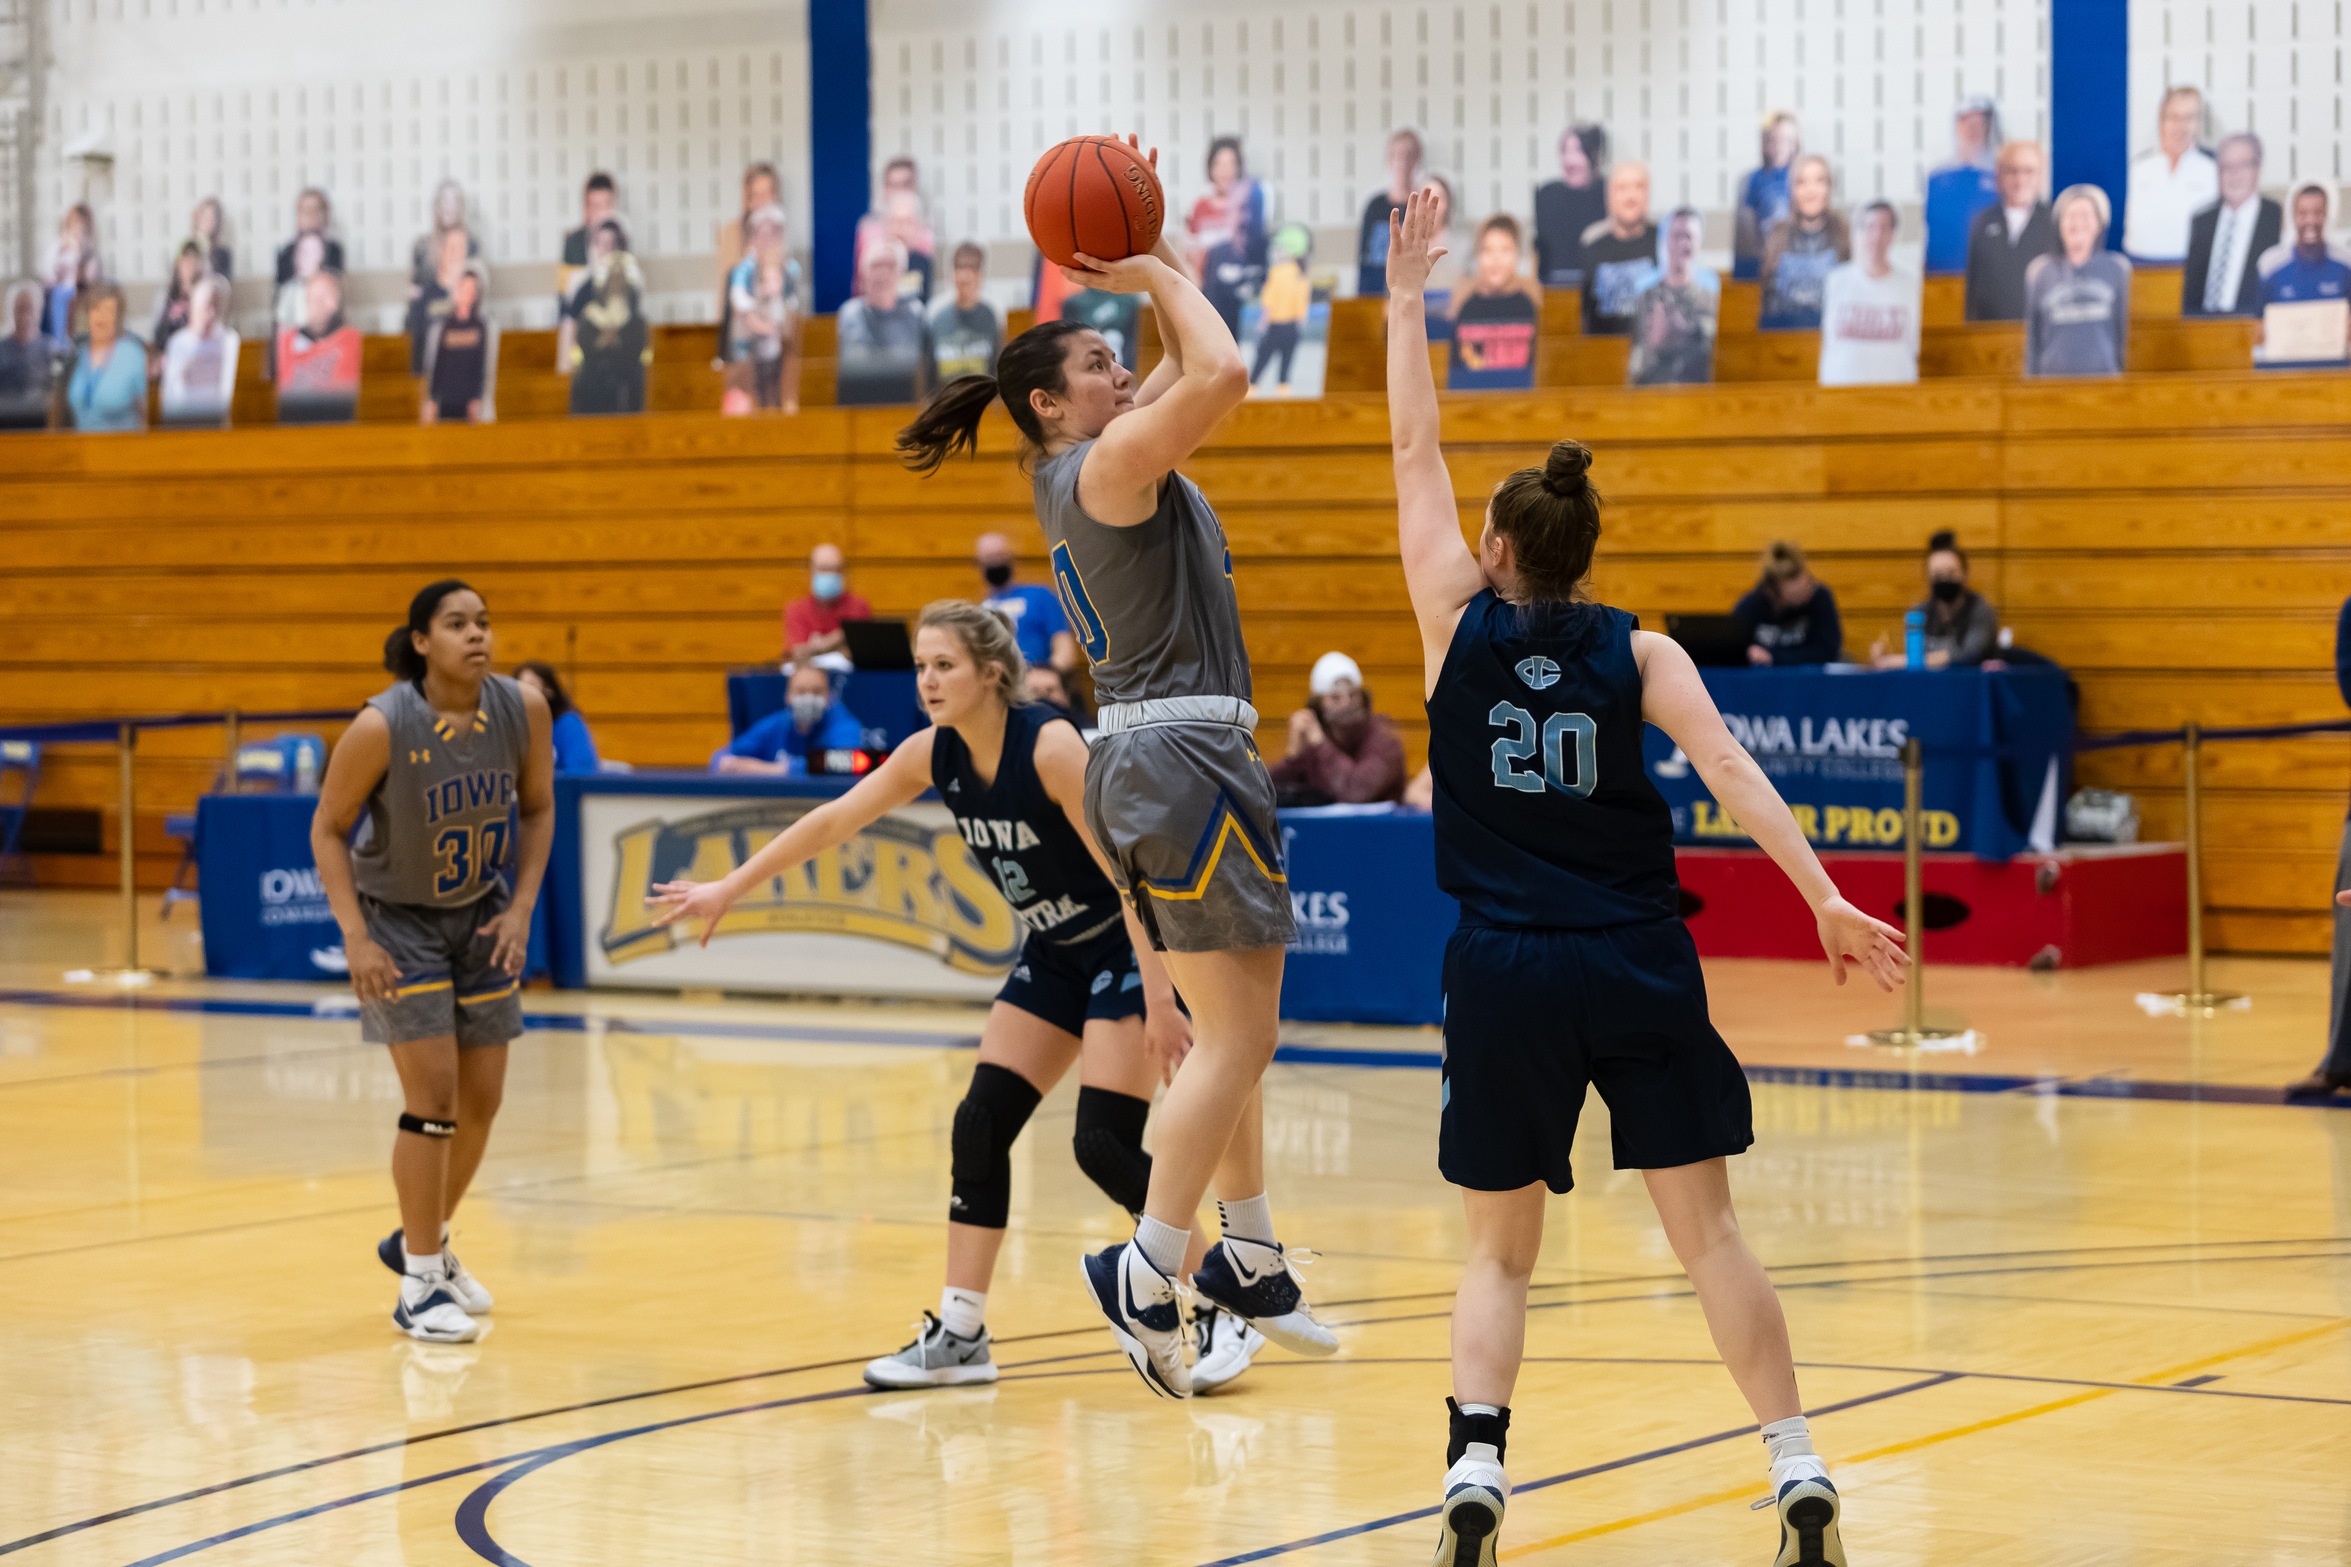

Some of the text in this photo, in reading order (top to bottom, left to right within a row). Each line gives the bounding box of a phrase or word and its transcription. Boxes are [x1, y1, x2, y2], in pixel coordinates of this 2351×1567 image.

[1123, 164, 1160, 250] PALDING
[1489, 700, 1597, 799] 20
[1720, 712, 1909, 759] OWA LAKES
[957, 816, 1041, 851] IOWA
[1825, 806, 1959, 845] PROD
[433, 816, 511, 898] 30
[991, 855, 1037, 904] 12
[1017, 893, 1089, 932] TRAL
[1290, 892, 1350, 927] KES
